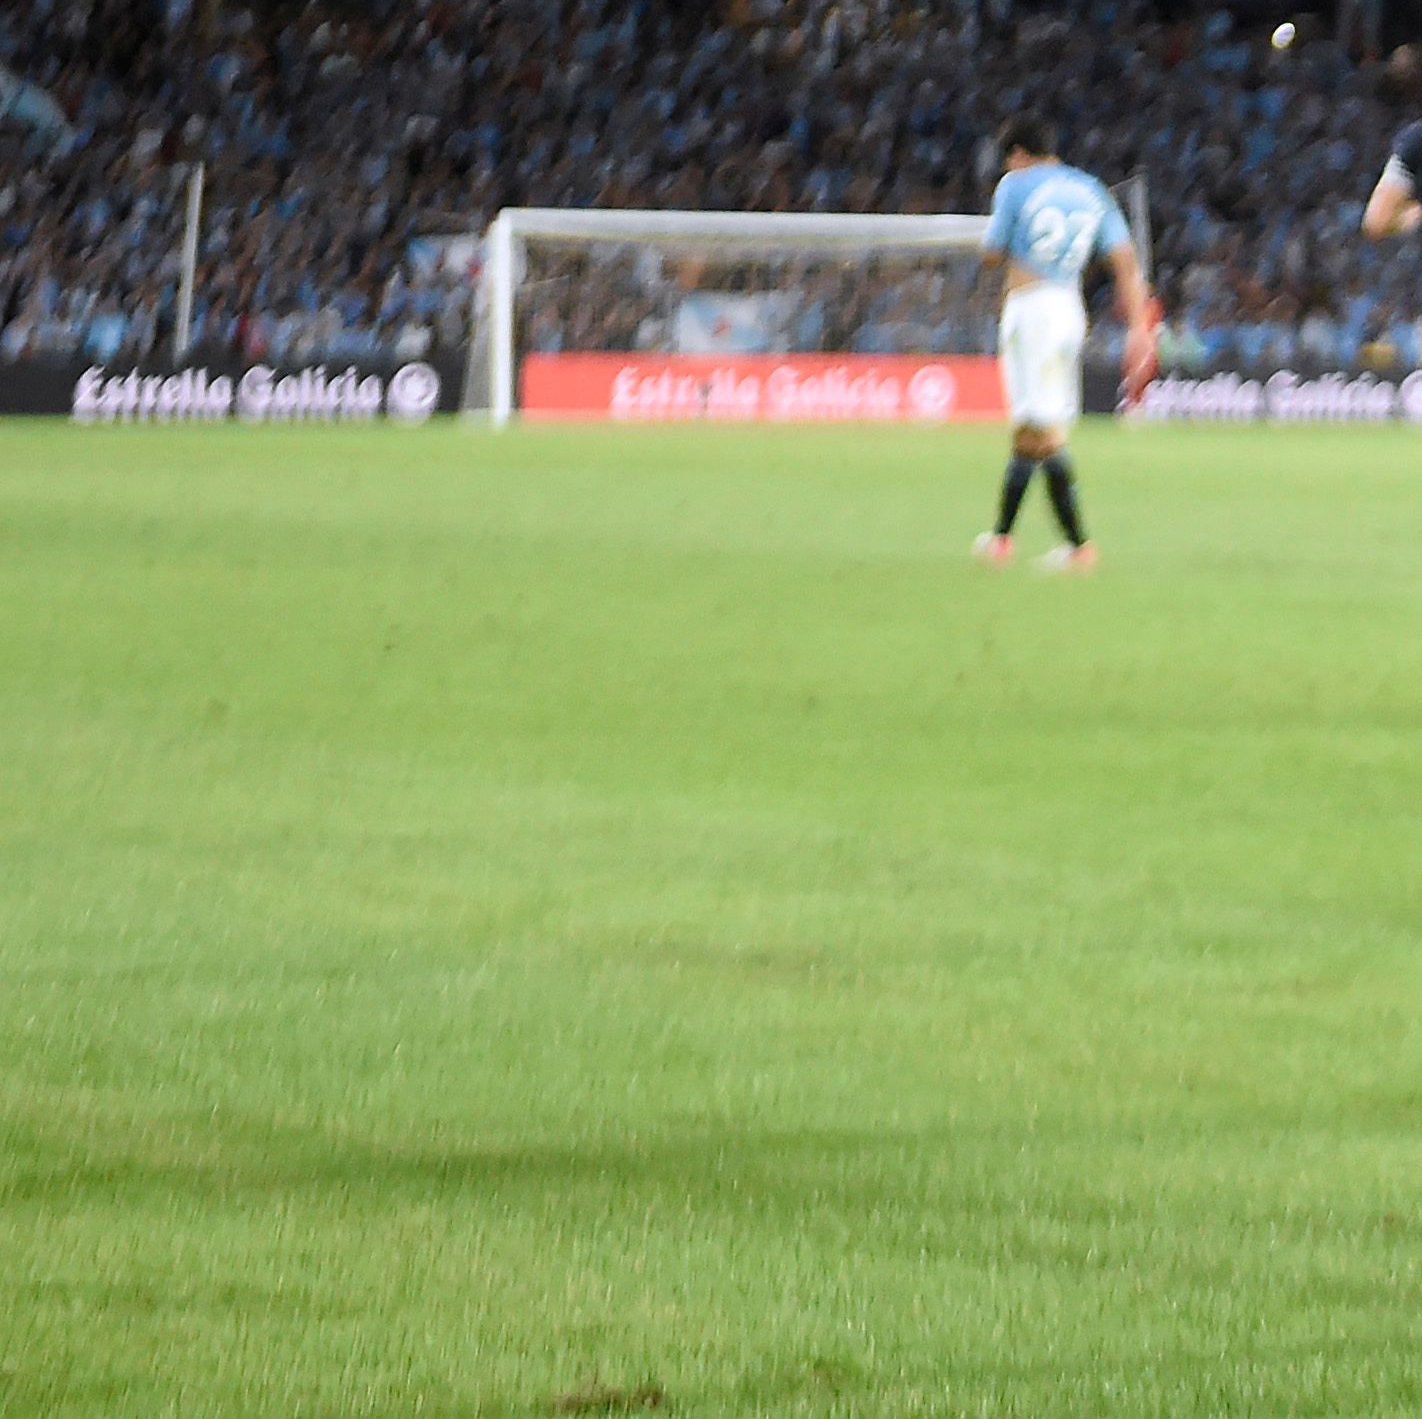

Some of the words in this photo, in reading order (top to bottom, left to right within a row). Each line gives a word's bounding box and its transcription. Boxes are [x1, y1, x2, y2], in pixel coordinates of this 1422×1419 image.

[71, 364, 232, 423] Estrella
[236, 363, 382, 423] Galicia
[610, 365, 760, 420] Estrlla
